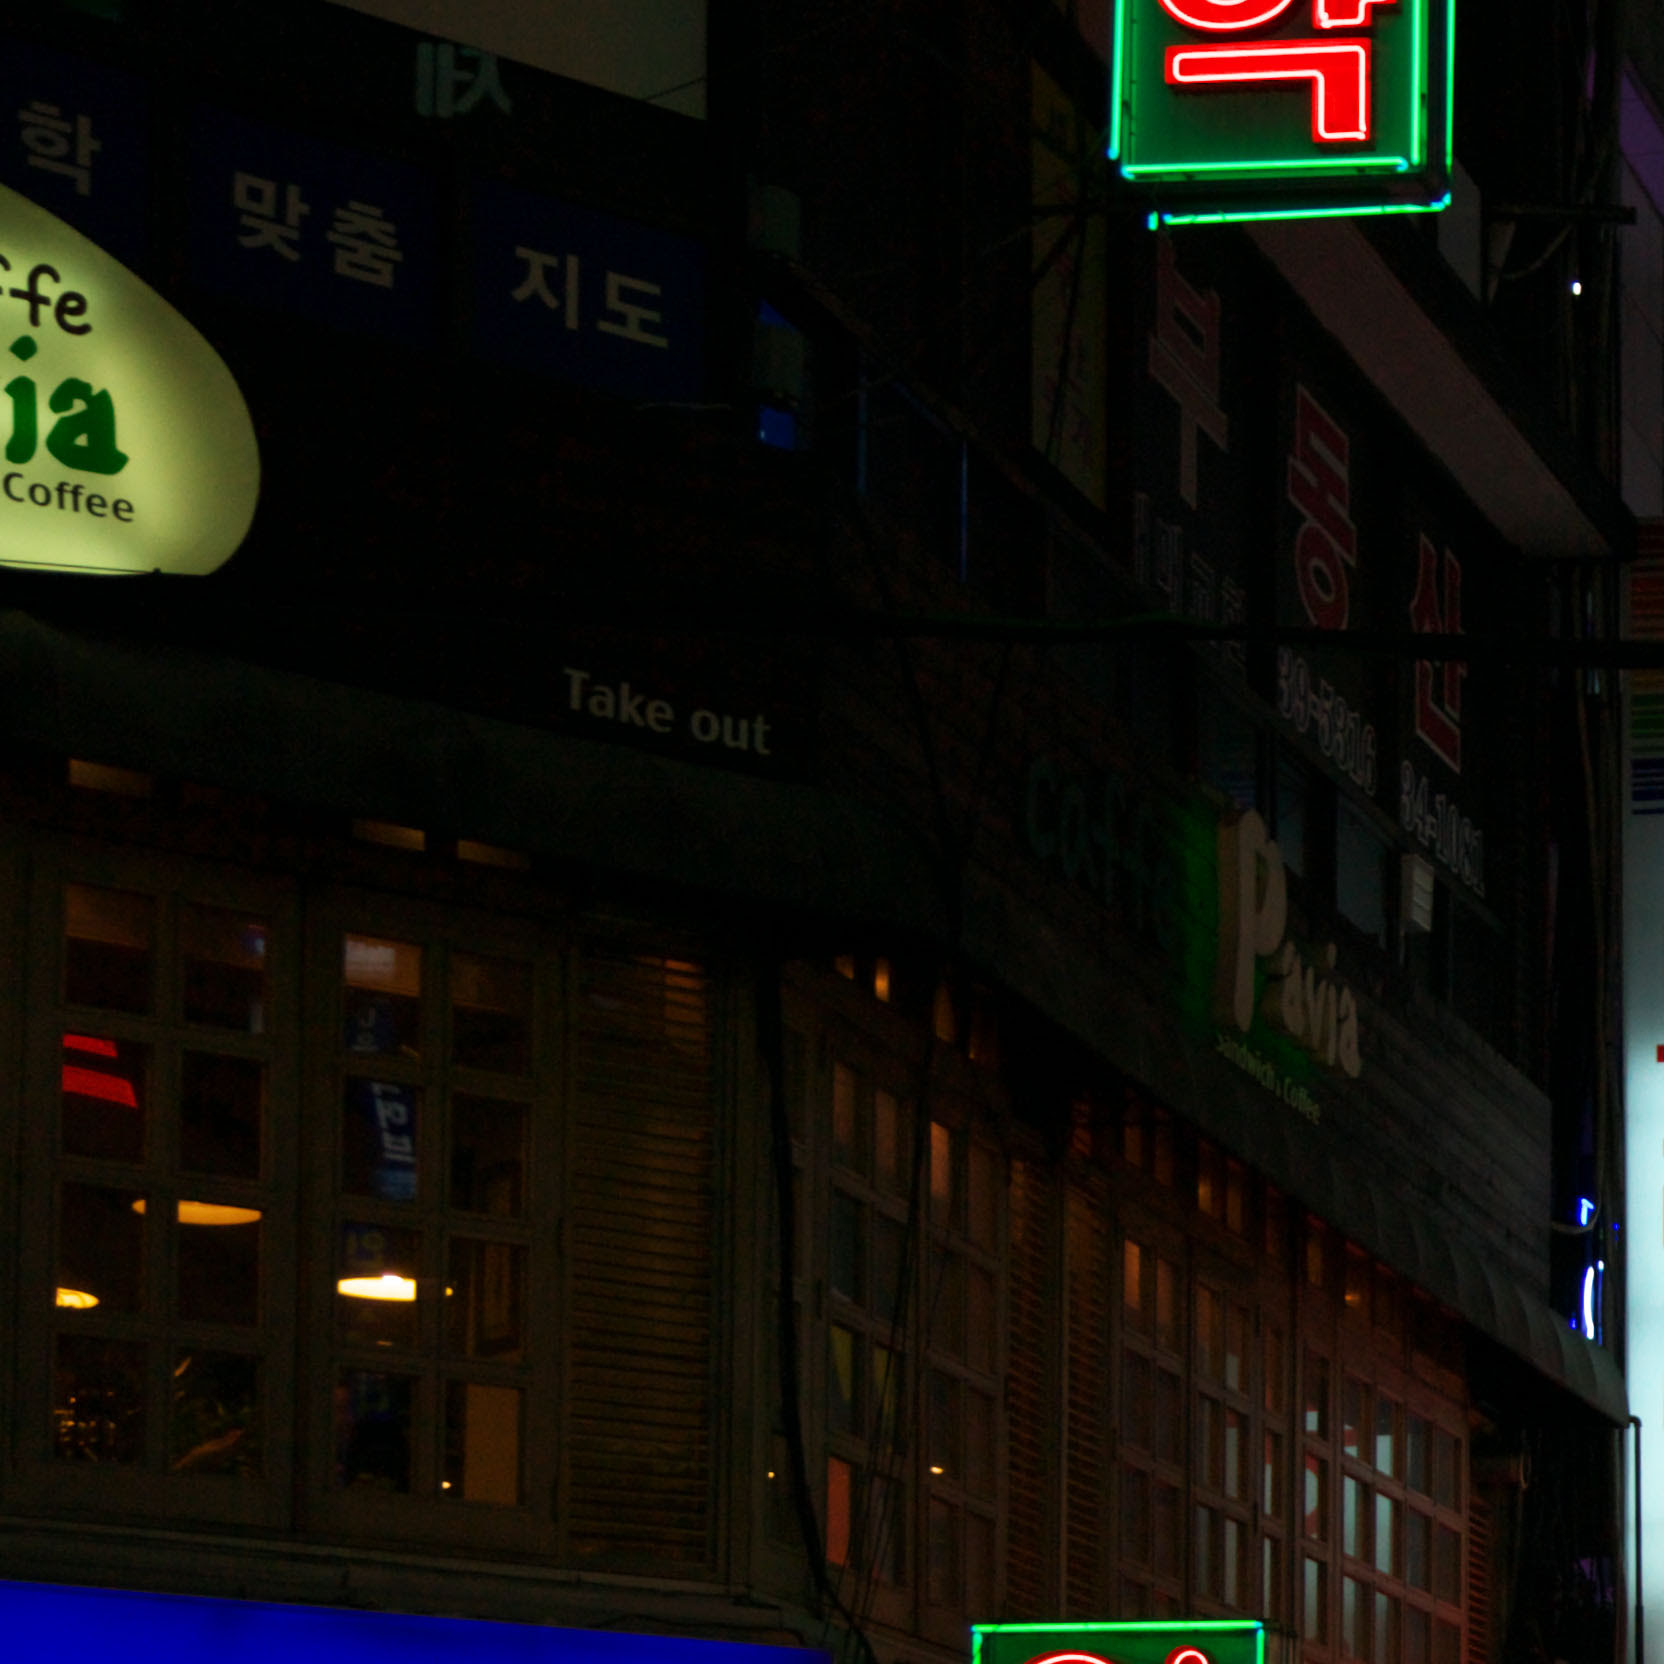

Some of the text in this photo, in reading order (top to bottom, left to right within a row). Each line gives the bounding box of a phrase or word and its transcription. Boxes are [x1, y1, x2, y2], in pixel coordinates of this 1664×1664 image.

[232, 170, 404, 290] 맞춤
[512, 244, 670, 350] 지도
[2, 472, 136, 525] Coffee
[565, 666, 774, 757] Take out
[1231, 806, 1364, 1082] Pavia
